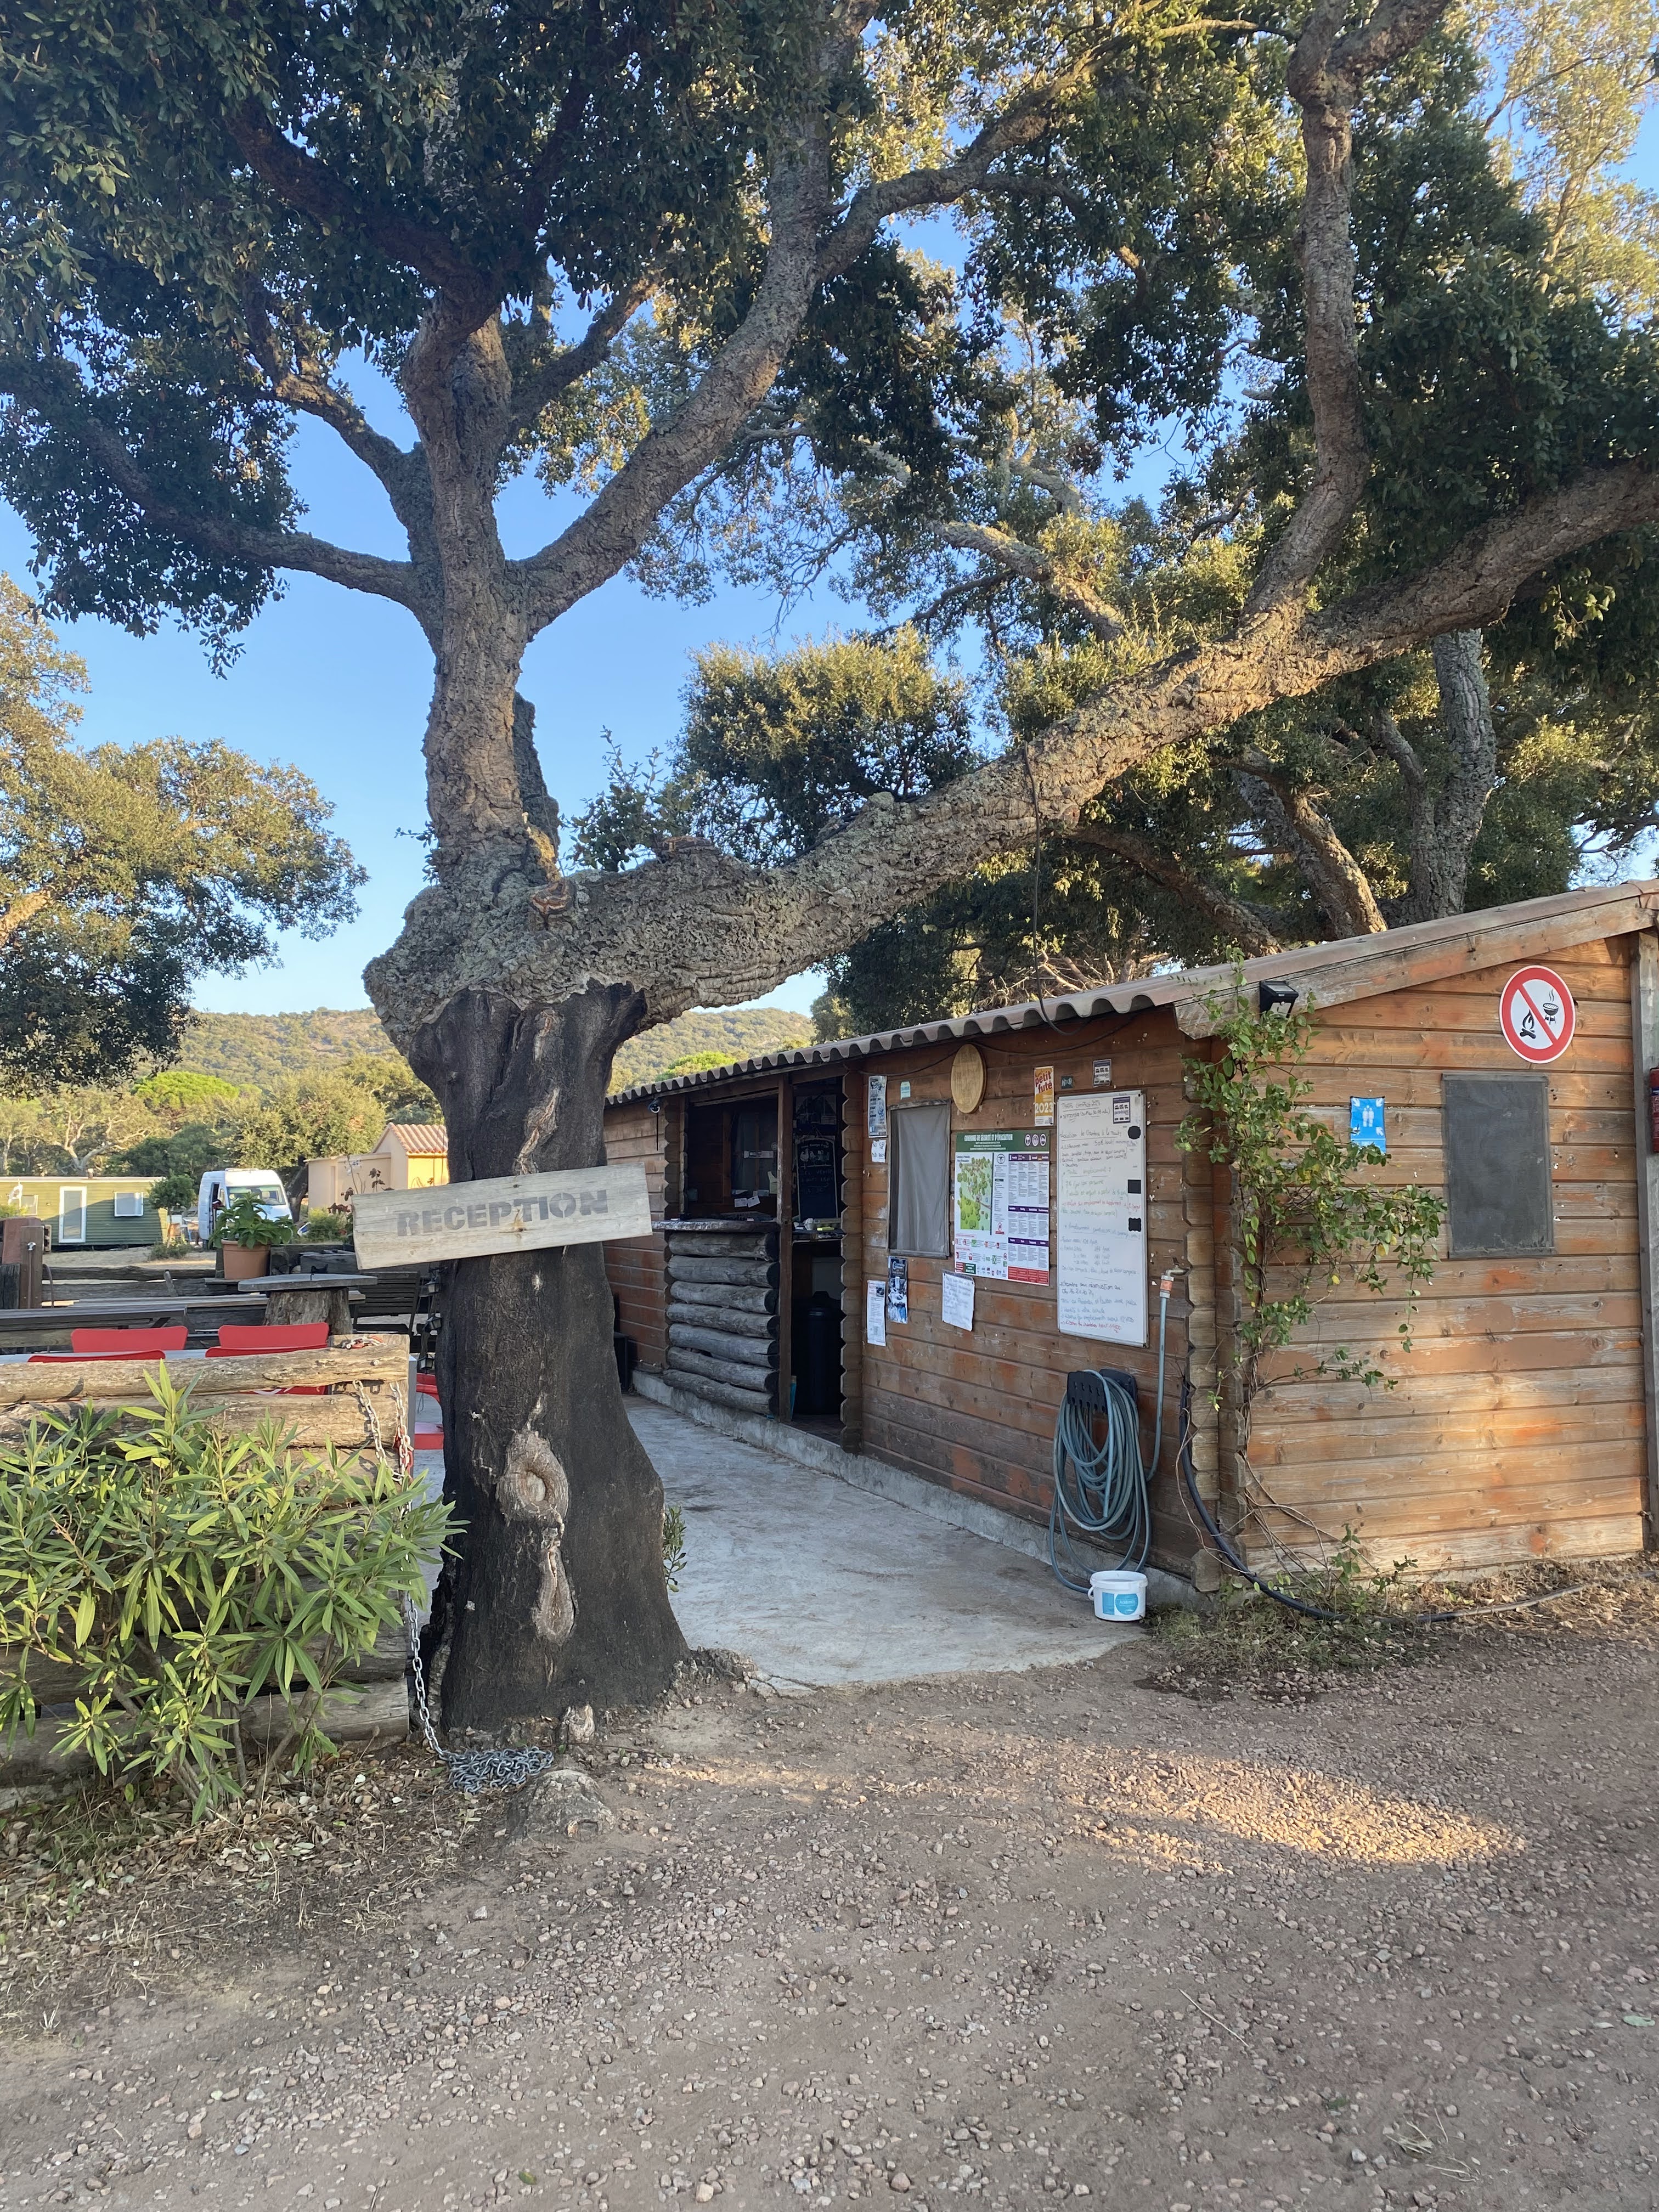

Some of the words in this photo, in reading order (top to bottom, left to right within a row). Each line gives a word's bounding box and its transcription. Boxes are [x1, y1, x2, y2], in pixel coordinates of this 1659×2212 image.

[1035, 1071, 1051, 1087] petit
[1035, 1102, 1053, 1113] 2023
[396, 1189, 608, 1237] RECEPTION
